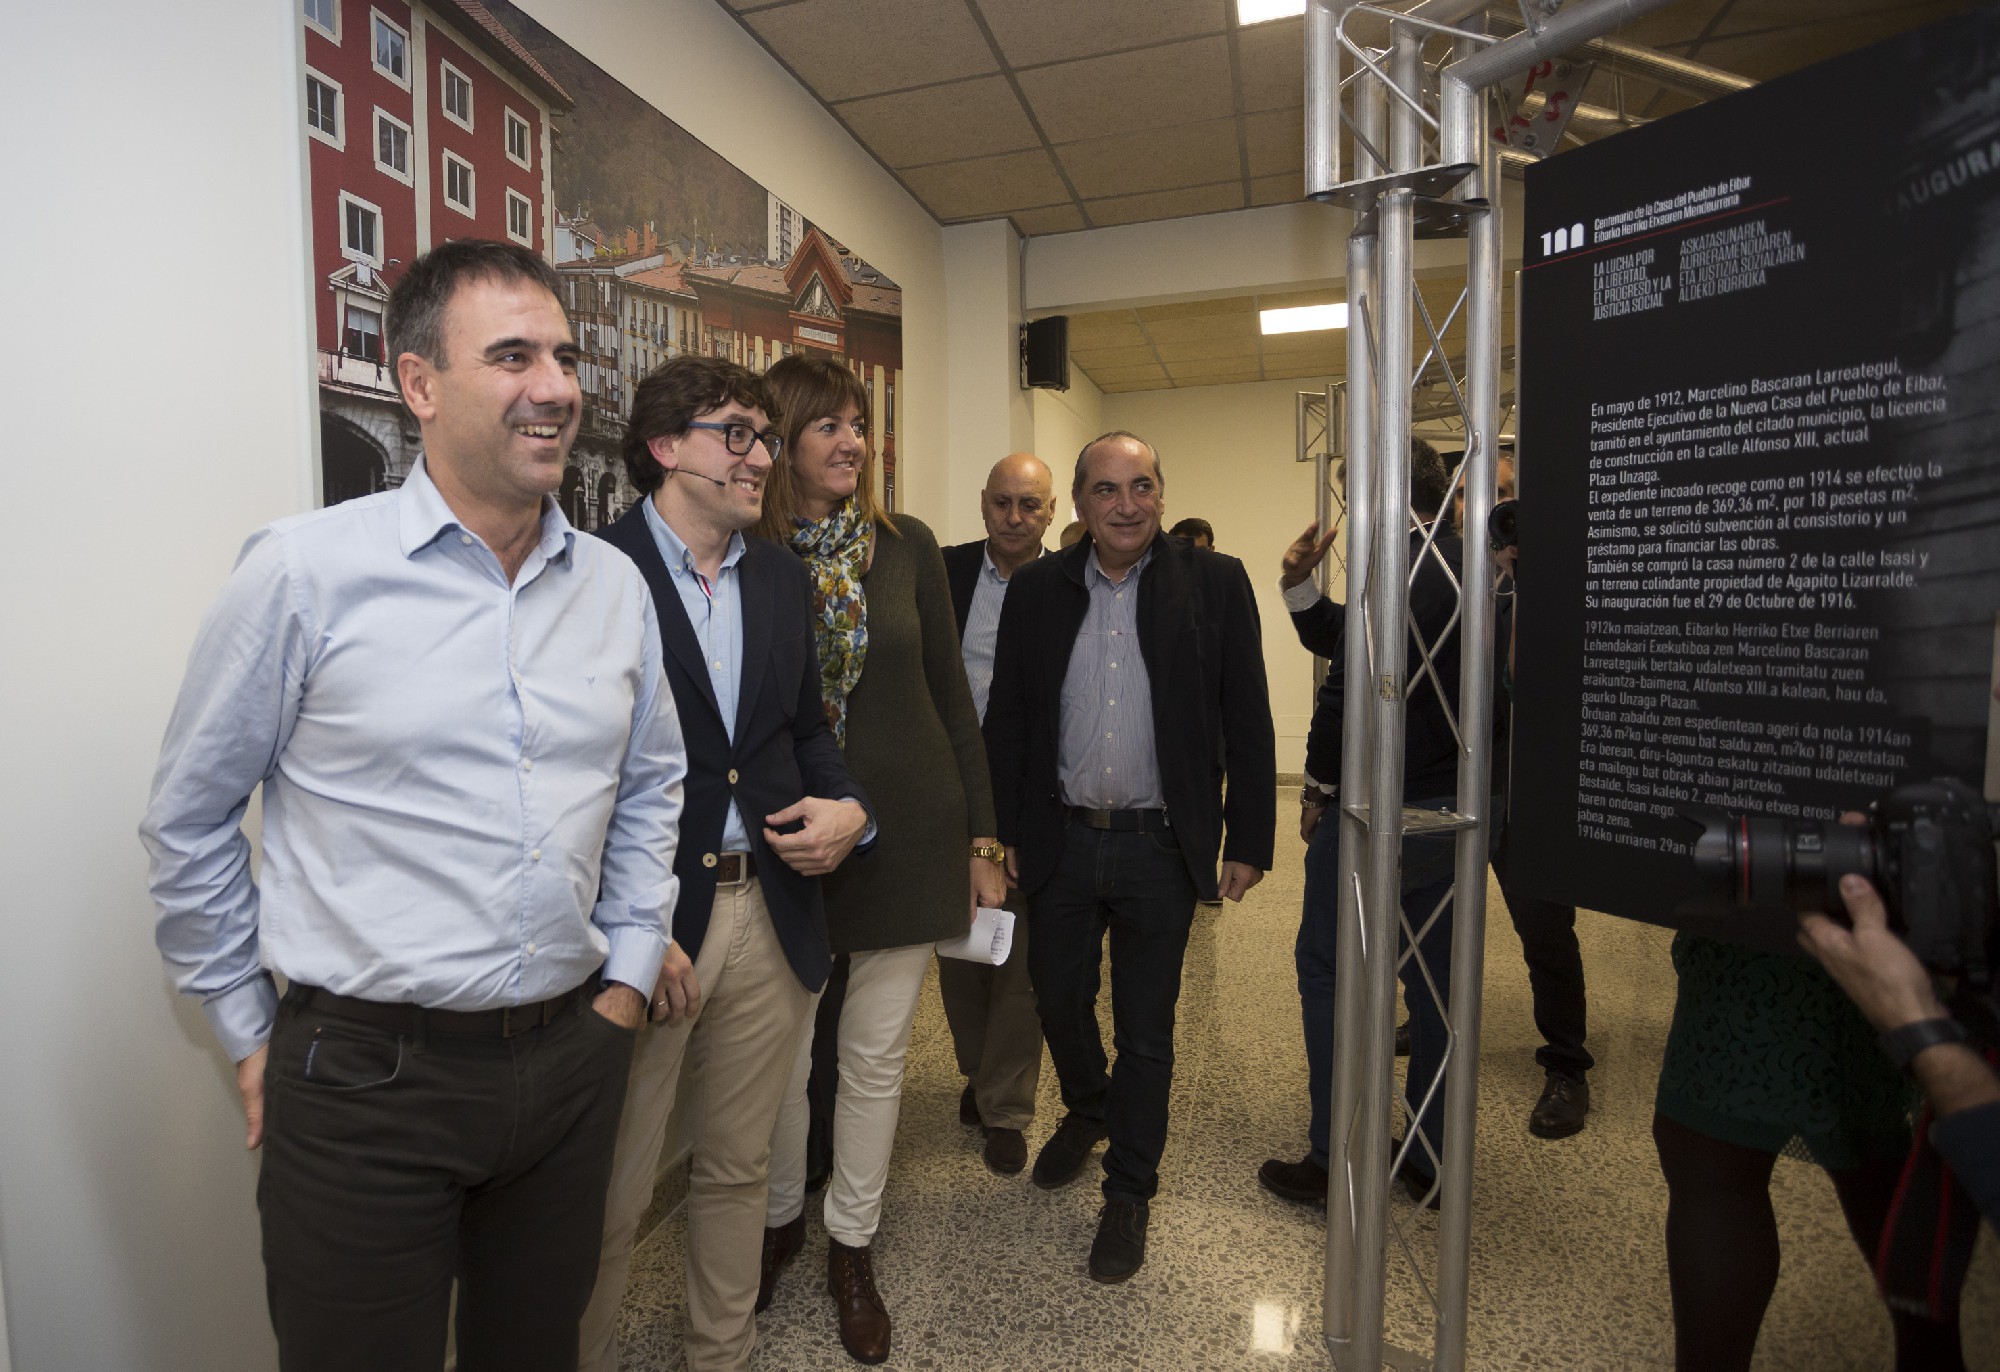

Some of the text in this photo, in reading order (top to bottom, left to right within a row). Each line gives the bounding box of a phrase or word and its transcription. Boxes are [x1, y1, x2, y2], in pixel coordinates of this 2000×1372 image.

[1594, 175, 1751, 231] Centenario Casa del Pueblo Eibar
[1594, 193, 1739, 244] Eibarko Herriko Etxearen Mendeurrena
[1605, 249, 1654, 274] LUCHA POR
[1679, 230, 1791, 271] AURRERAMENDUAREN
[1679, 243, 1805, 287] ETA JUSTIZIA SOZIALAREN
[1604, 275, 1672, 303] PROGRESO LA
[1679, 270, 1766, 302] ALDEKO BORROKA
[1593, 293, 1664, 320] JUSTICIA SOCIAL
[1591, 374, 1811, 417] En mayo de Marcelino Bascaran
[1591, 379, 1900, 434] Presidente Ejecutivo de Nueva Casa del Pueblo de
[1590, 435, 1626, 452] tramitó
[1628, 435, 1641, 447] en
[1656, 422, 1731, 448] ayuntamiento
[1734, 419, 1752, 436] del
[1756, 414, 1794, 432] citado
[1870, 403, 1884, 419] la
[1888, 396, 1946, 417] licencia
[1589, 424, 1869, 469] de construcción en calle Alfonso actual
[1589, 470, 1660, 486] Plaza Unzaga.
[1601, 461, 1942, 506] expediente incoado recoge como en 1914 se efectúo la
[1588, 489, 1886, 521] venta de terreno de por 18 pesetas
[1659, 510, 1907, 535] solicitó subvención al consistorio un
[1587, 548, 1914, 574] También compró casa número de la calle Isasi
[1588, 536, 1779, 558] préstamo para financiar las obras.
[1602, 570, 1917, 592] terreno colindante propiedad de Agapito Lizarralde.
[1586, 593, 1856, 610] Su inauguración fue 29 de Octubre de 1916.
[1732, 623, 1879, 640] Herriko Etxe Berriaren
[1650, 640, 1869, 660] Exekutiboa Marcelino Bascaran
[1583, 655, 1864, 681] Larreateguik bertako udaletxean tramitatu zuen
[1582, 691, 1657, 709] gaurko Unzaga
[1693, 678, 1861, 701] Alfontso hau
[1581, 706, 1911, 747] Orduan zabaldu espedientean ageri da nola 1914an
[1644, 729, 1696, 746] lur-eremu
[1699, 733, 1717, 748] bat
[1719, 736, 1751, 752] saldu
[1819, 744, 1835, 759] 18
[1599, 761, 1729, 787] mailegu bat obrak abian
[1639, 747, 1894, 786] diru-laguntza eskatu zitzaion udaletxeari
[1578, 791, 1675, 819] haren ondoan zego
[1626, 780, 1650, 795] Isasi
[1652, 784, 1688, 800] kaleko
[1704, 792, 1762, 811] zenbakiko
[1766, 801, 1799, 815] etxea
[1803, 805, 1835, 820] erosi
[1577, 808, 1604, 823] jabea
[1577, 824, 1612, 841] 1916ko
[1615, 834, 1656, 849] urriaren
[1660, 838, 1686, 855] 29an
